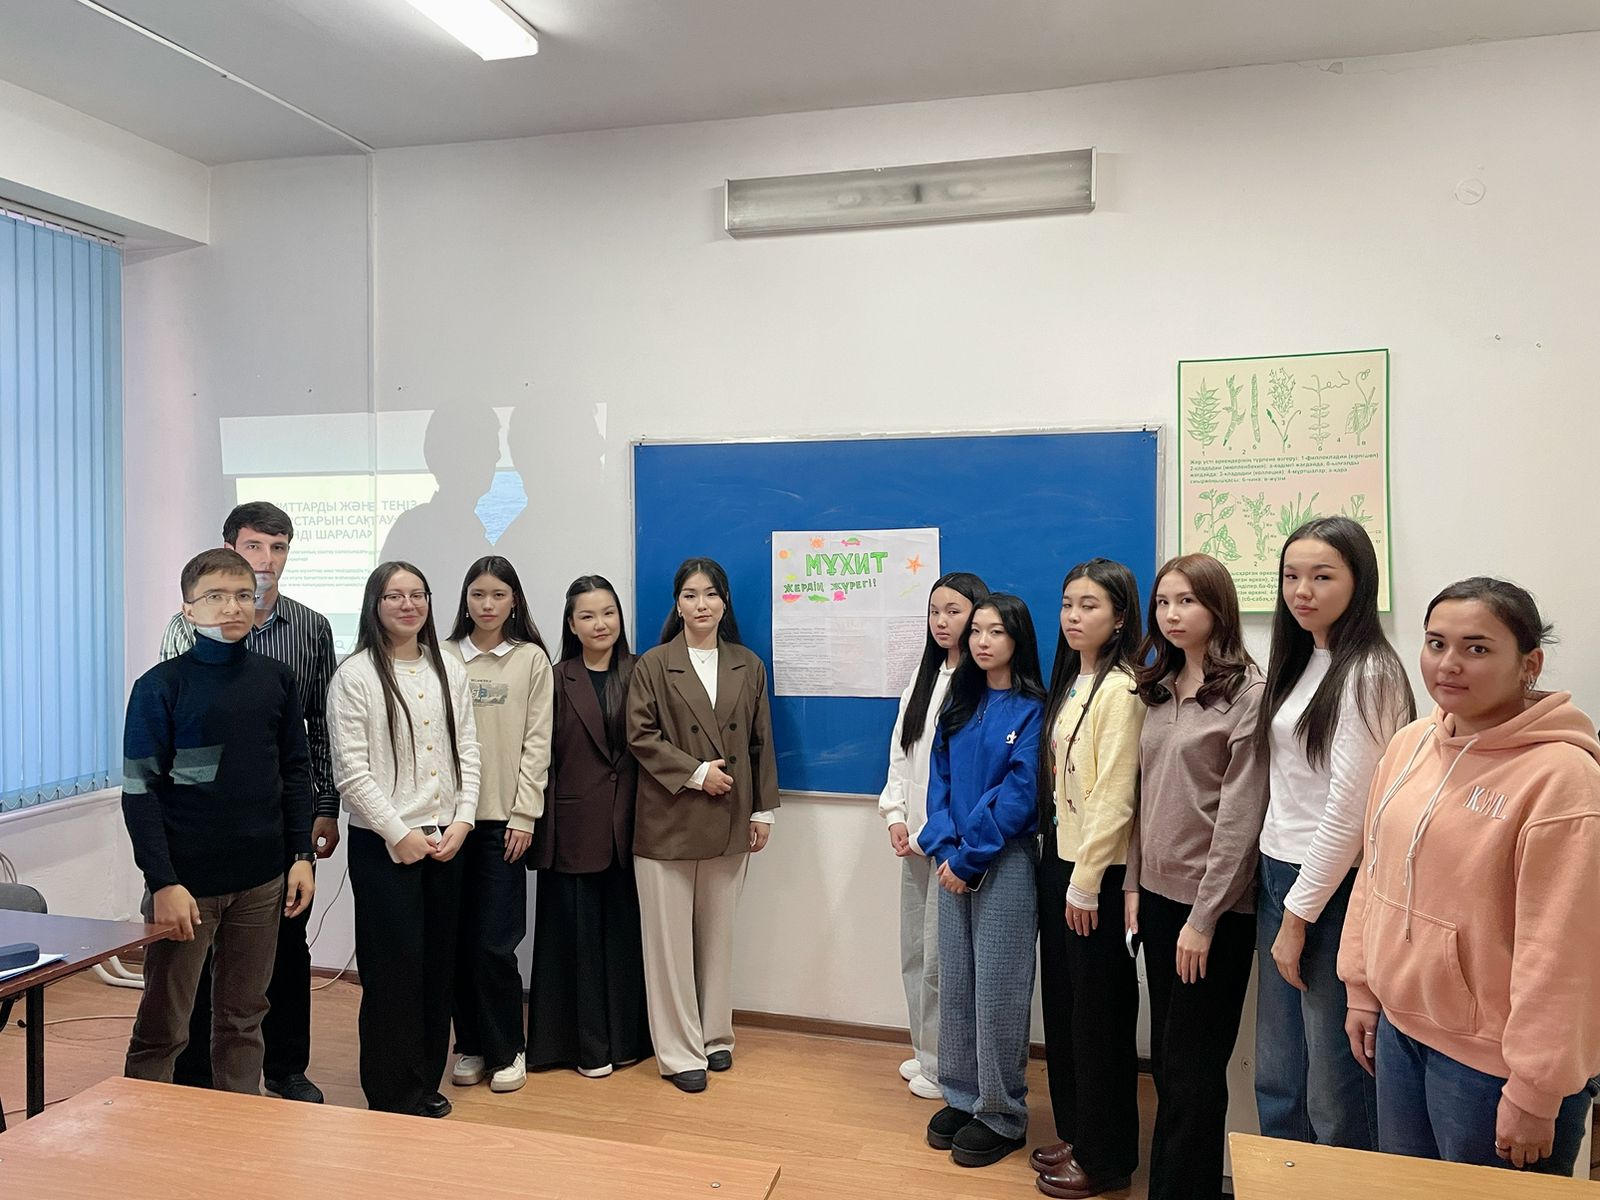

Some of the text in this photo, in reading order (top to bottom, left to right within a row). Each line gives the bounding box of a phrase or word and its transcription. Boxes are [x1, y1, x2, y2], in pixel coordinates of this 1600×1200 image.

[340, 501, 375, 512] ЖӘНЕ
[292, 515, 344, 526] СТАРЫН
[315, 529, 373, 541] ШАРАЛАР
[805, 551, 889, 577] МҰХИТ
